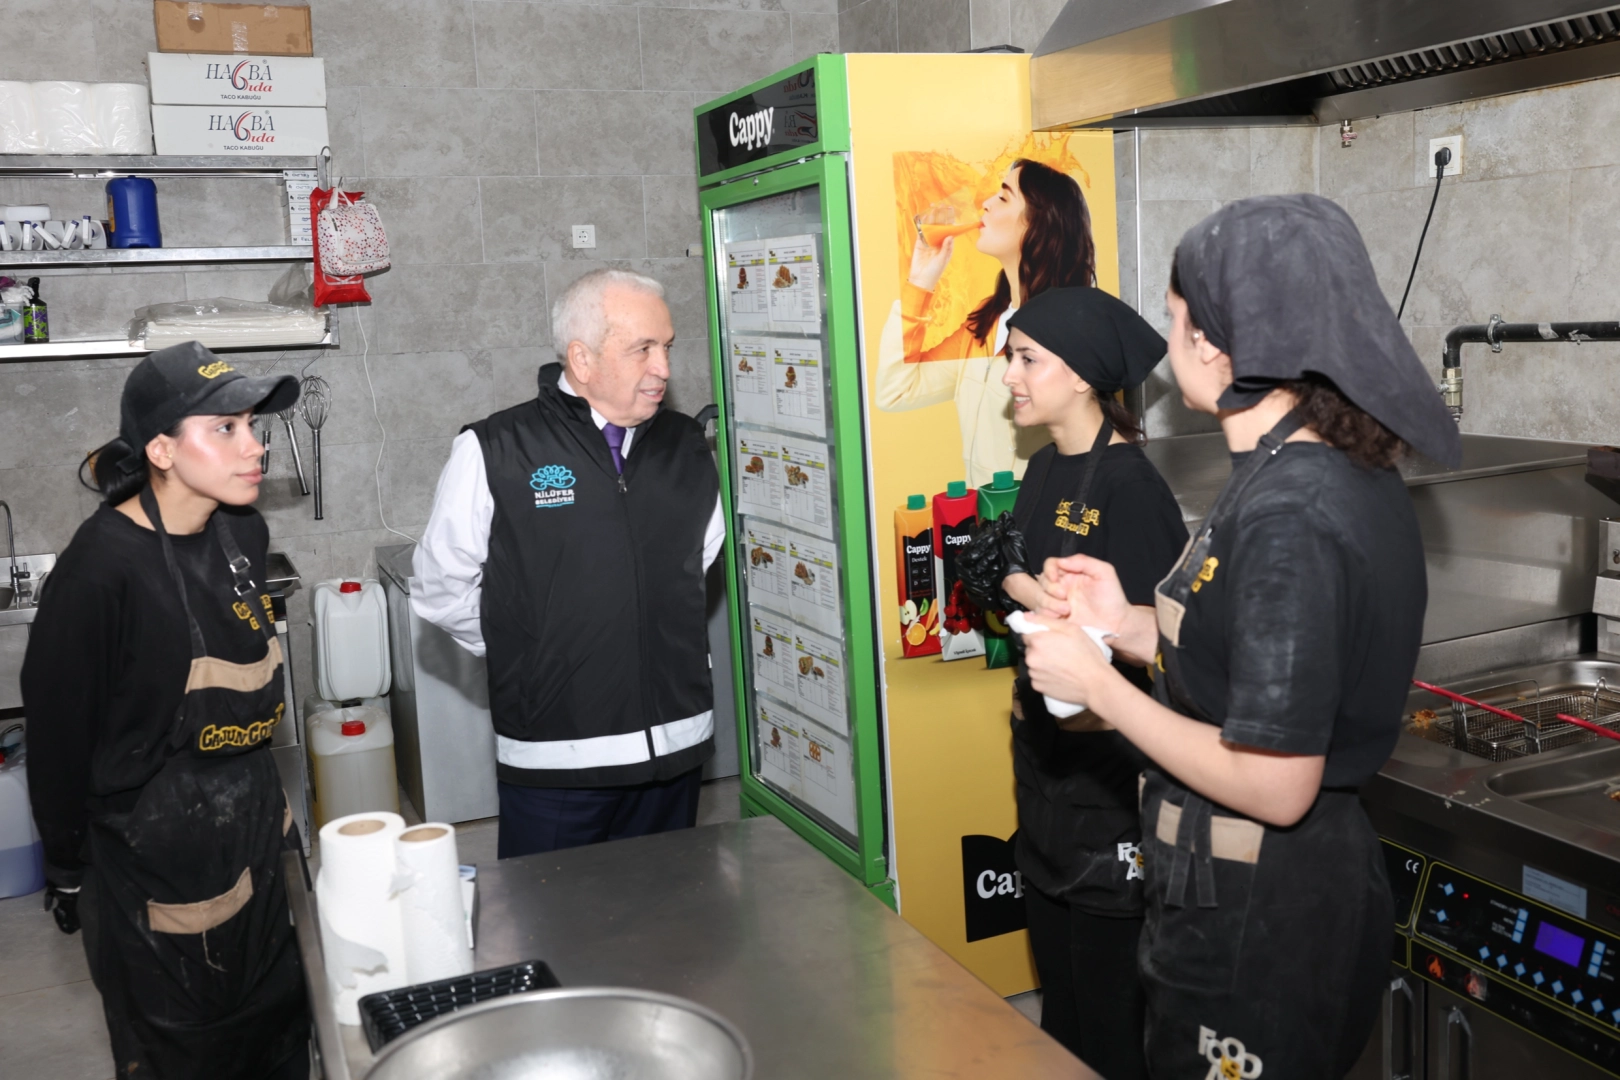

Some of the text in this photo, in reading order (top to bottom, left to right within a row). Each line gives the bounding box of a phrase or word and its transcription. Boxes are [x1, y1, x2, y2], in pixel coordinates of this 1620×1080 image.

[729, 106, 774, 151] Cappy
[534, 488, 575, 499] NİLÜFER
[906, 544, 931, 555] Cappy
[199, 724, 248, 751] CAJUN
[1198, 1024, 1263, 1080] FOOD
